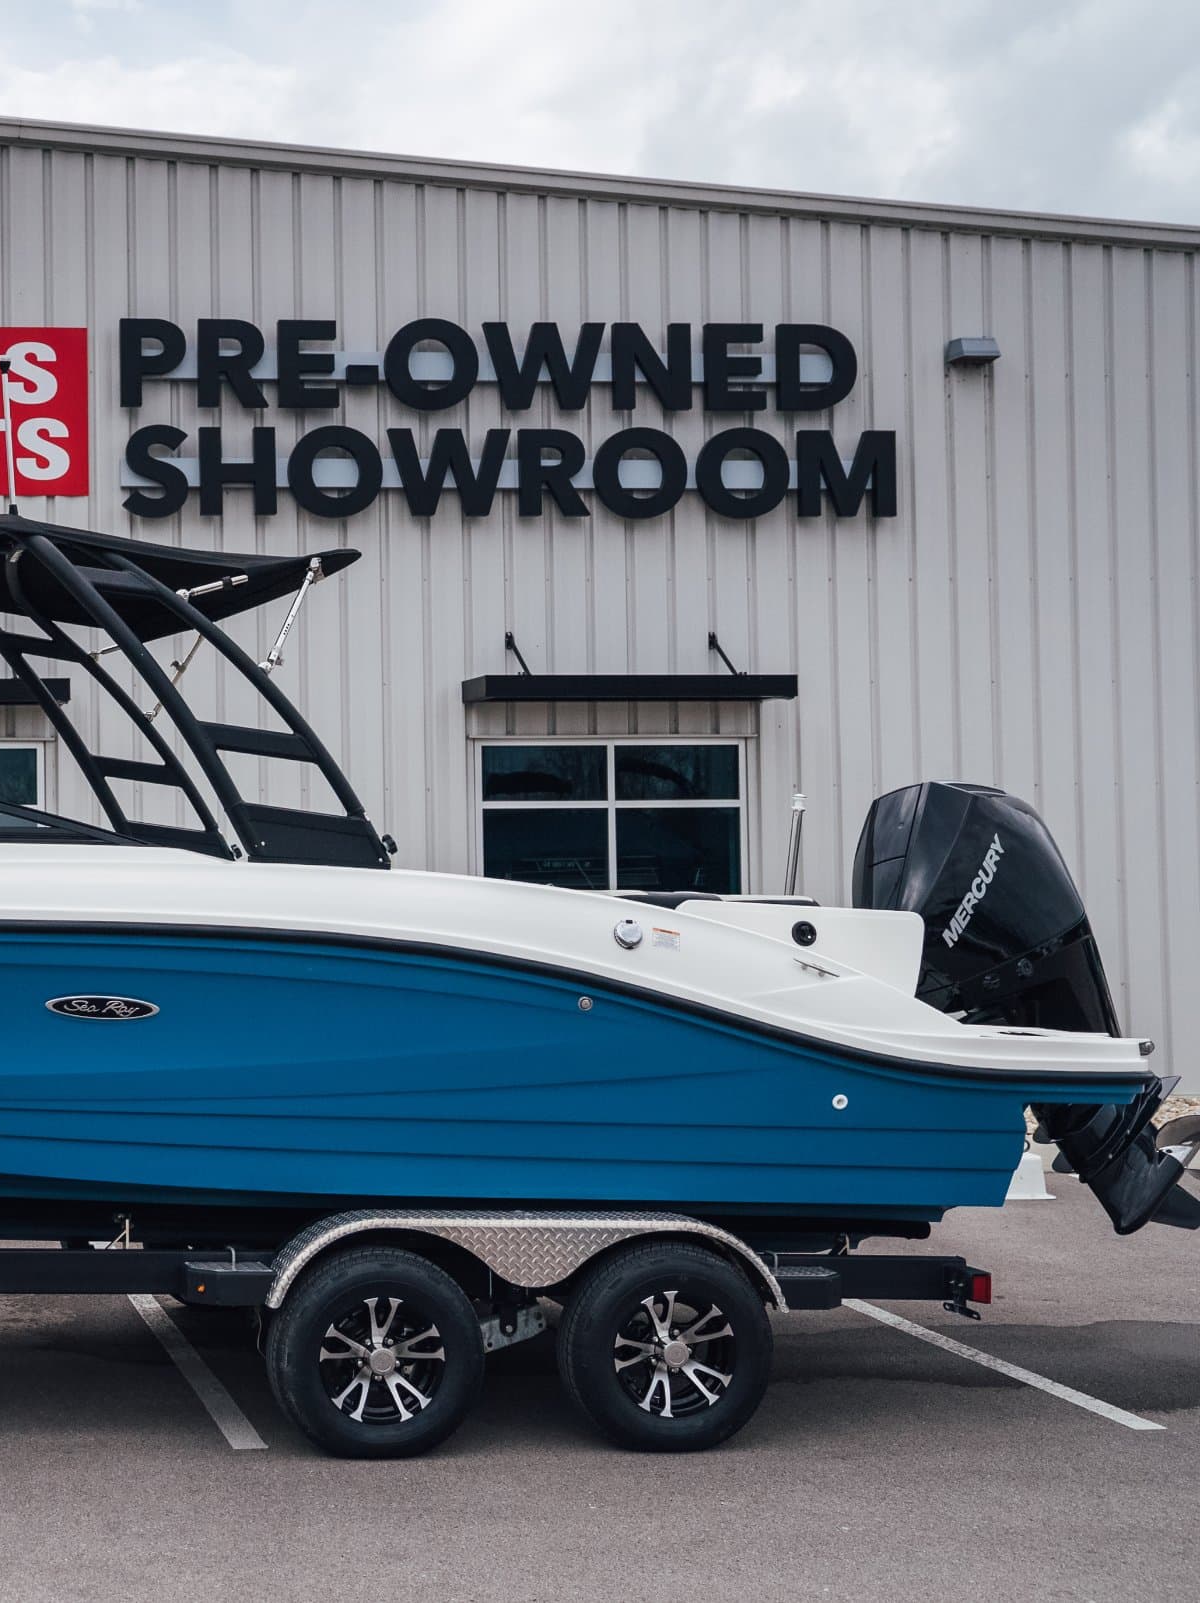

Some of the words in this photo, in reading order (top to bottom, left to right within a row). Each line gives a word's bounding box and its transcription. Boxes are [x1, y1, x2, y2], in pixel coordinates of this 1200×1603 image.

[119, 317, 858, 412] PRE-OWNED
[122, 424, 897, 519] SHOWROOM
[942, 833, 1004, 948] MERCURY
[64, 1000, 100, 1013] Sea
[101, 1000, 140, 1017] Ray
